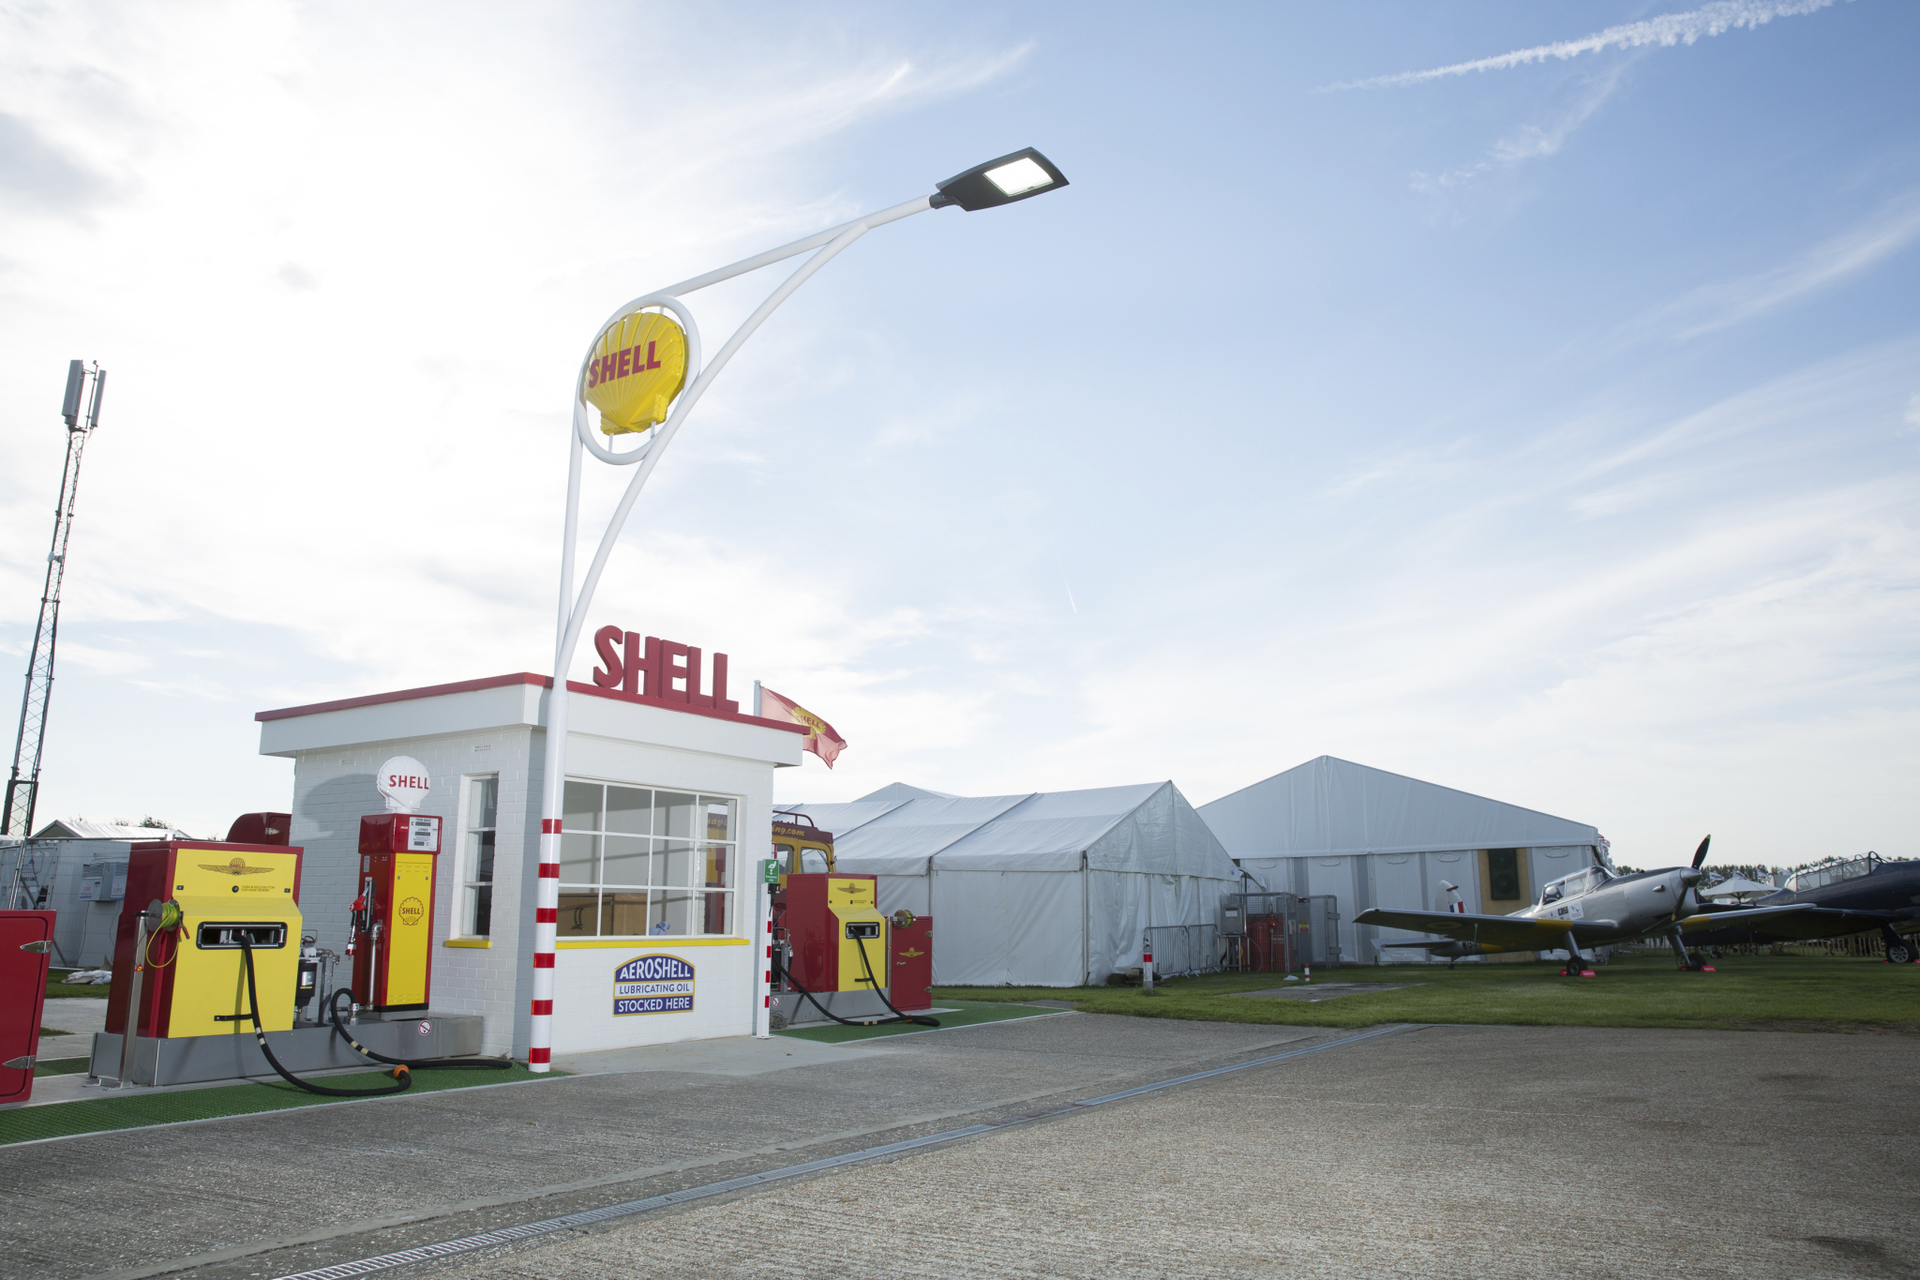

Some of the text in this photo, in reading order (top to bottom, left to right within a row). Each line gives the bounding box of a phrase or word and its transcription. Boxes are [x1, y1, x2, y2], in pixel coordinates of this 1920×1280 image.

[589, 341, 661, 388] SHELL
[593, 625, 739, 713] SHELL
[796, 715, 821, 729] SHELL
[389, 775, 429, 789] SHELL
[402, 907, 420, 915] SHELL
[619, 957, 691, 980] AEROSHELL
[619, 983, 690, 995] LUBRICATING OIL
[618, 997, 690, 1012] STOCKED HERE
